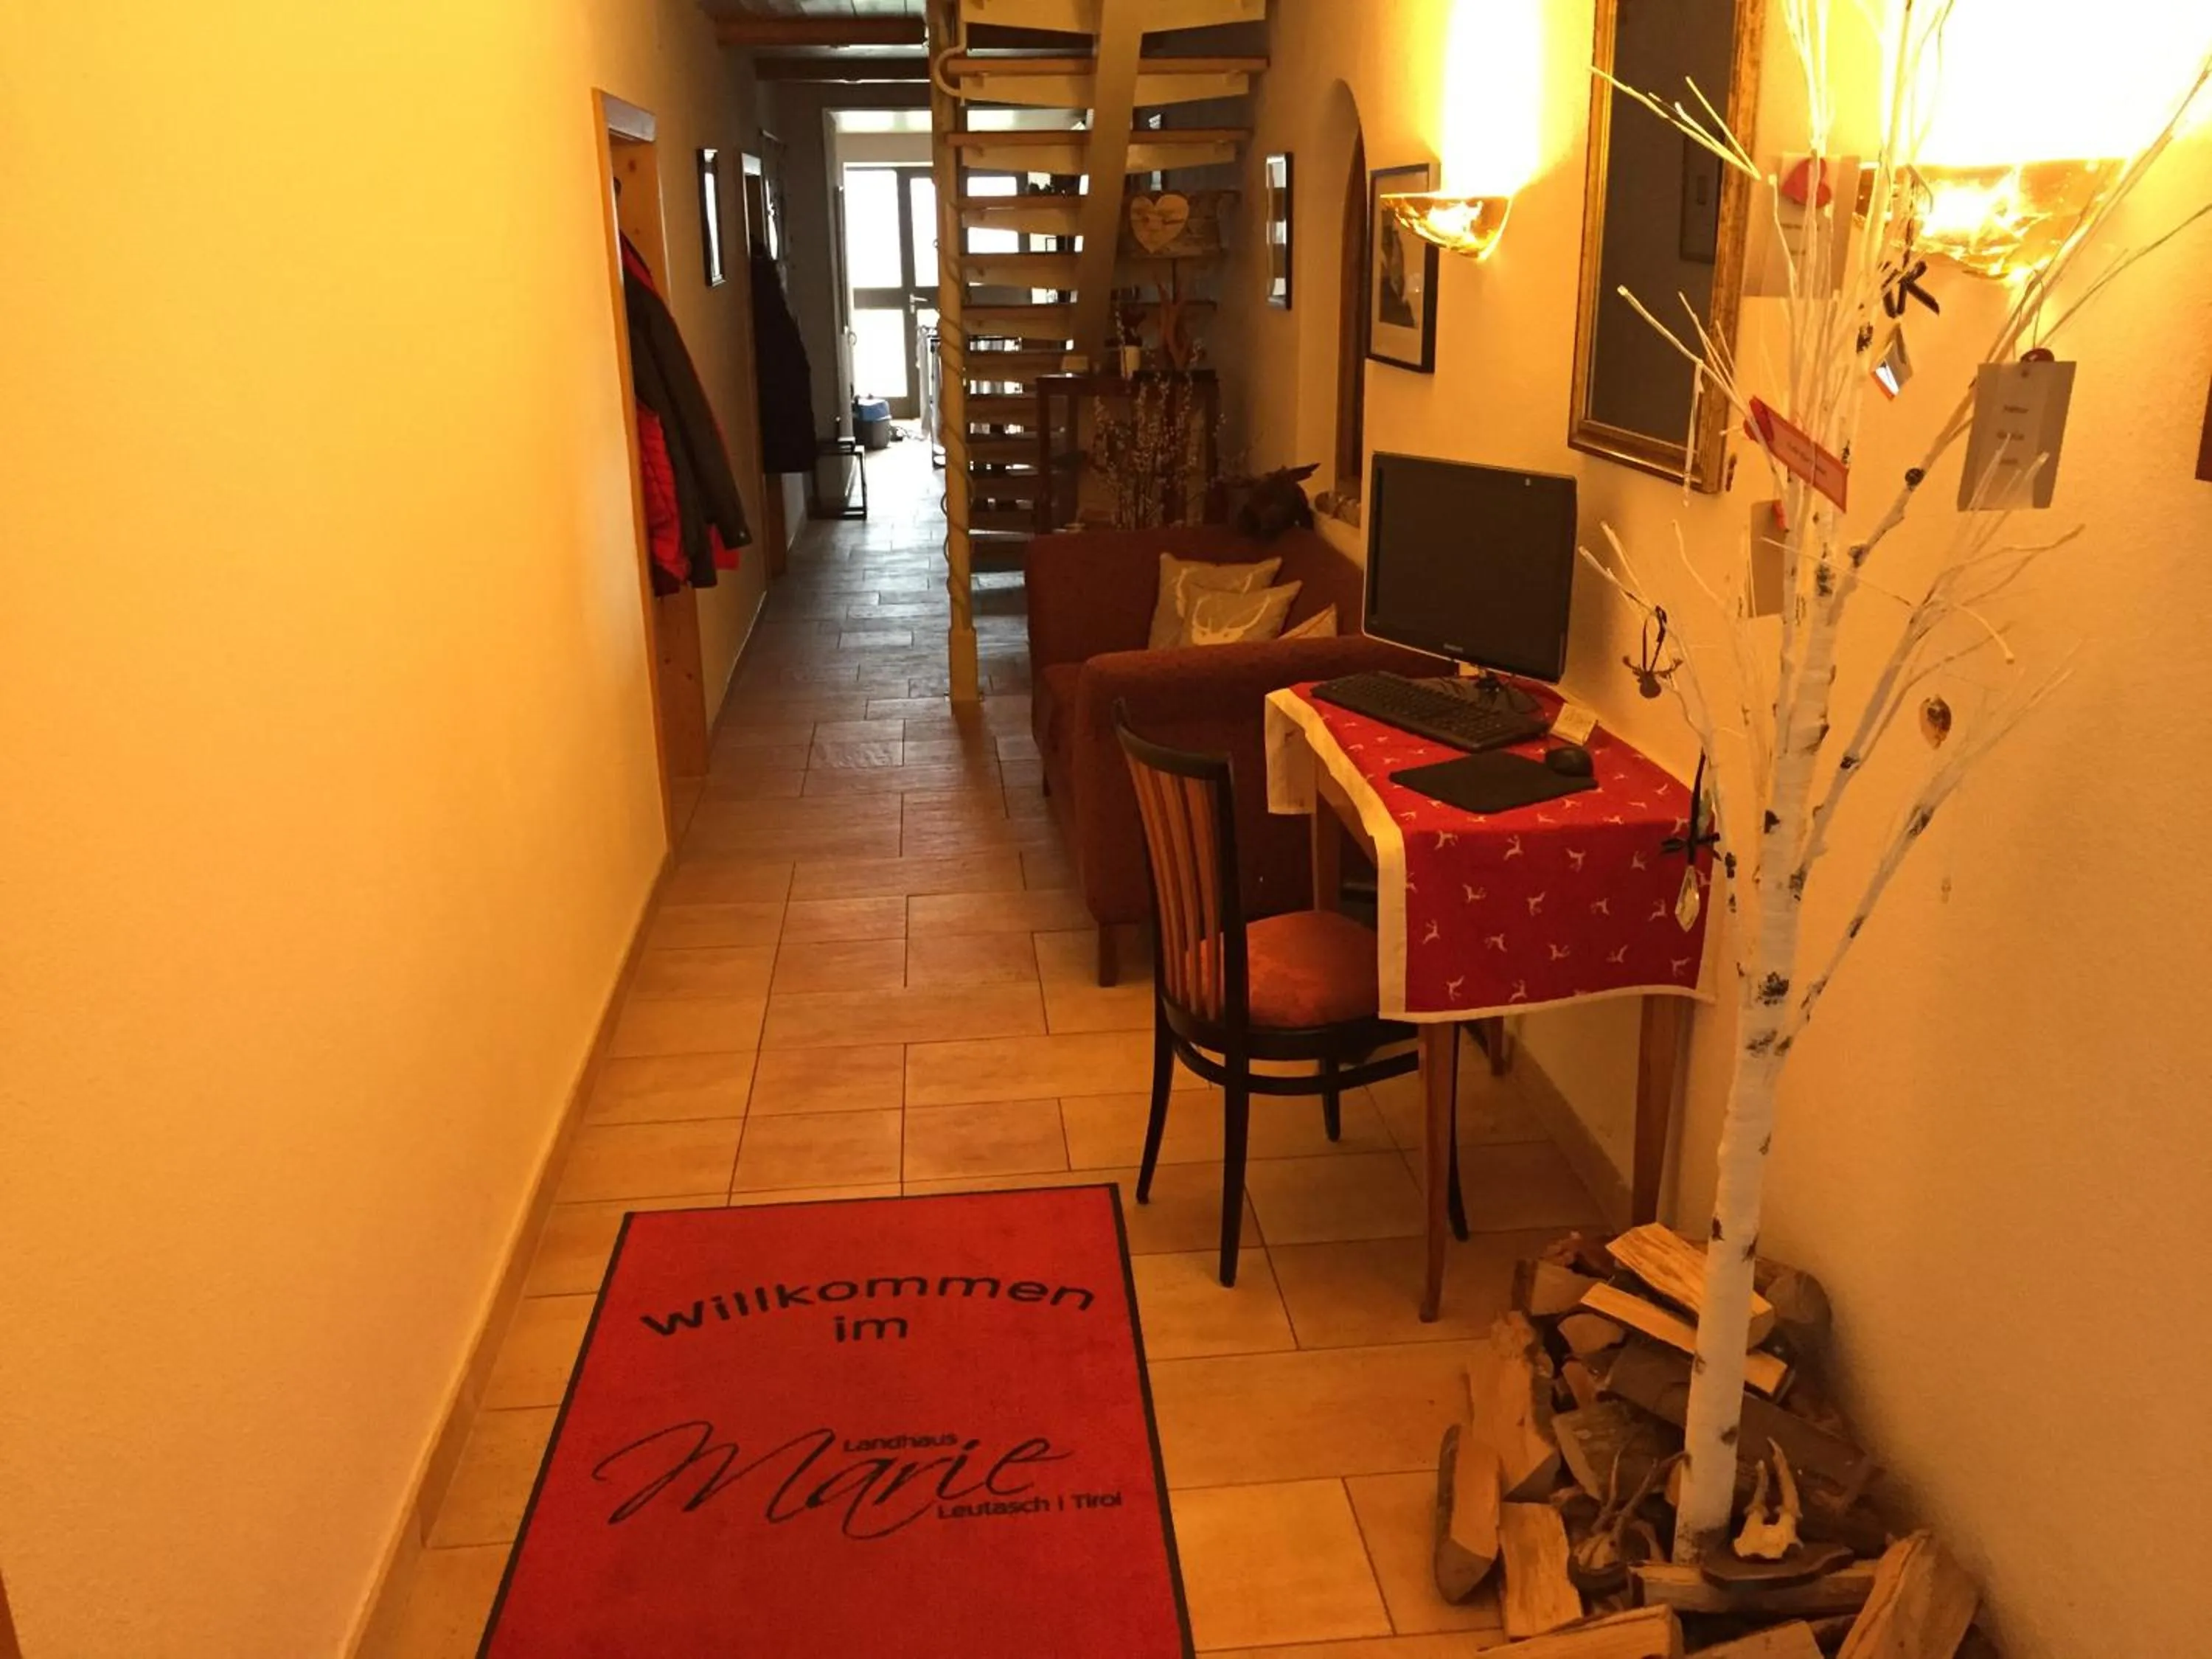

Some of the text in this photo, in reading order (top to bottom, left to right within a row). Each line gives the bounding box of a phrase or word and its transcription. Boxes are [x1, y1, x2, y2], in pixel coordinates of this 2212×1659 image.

[640, 1275, 1095, 1336] Willkommen
[834, 1315, 909, 1343] im
[843, 1433, 958, 1453] Landhaus
[592, 1420, 1075, 1540] Marie
[938, 1495, 1049, 1520] Leutasch
[1071, 1491, 1122, 1509] Tirol
